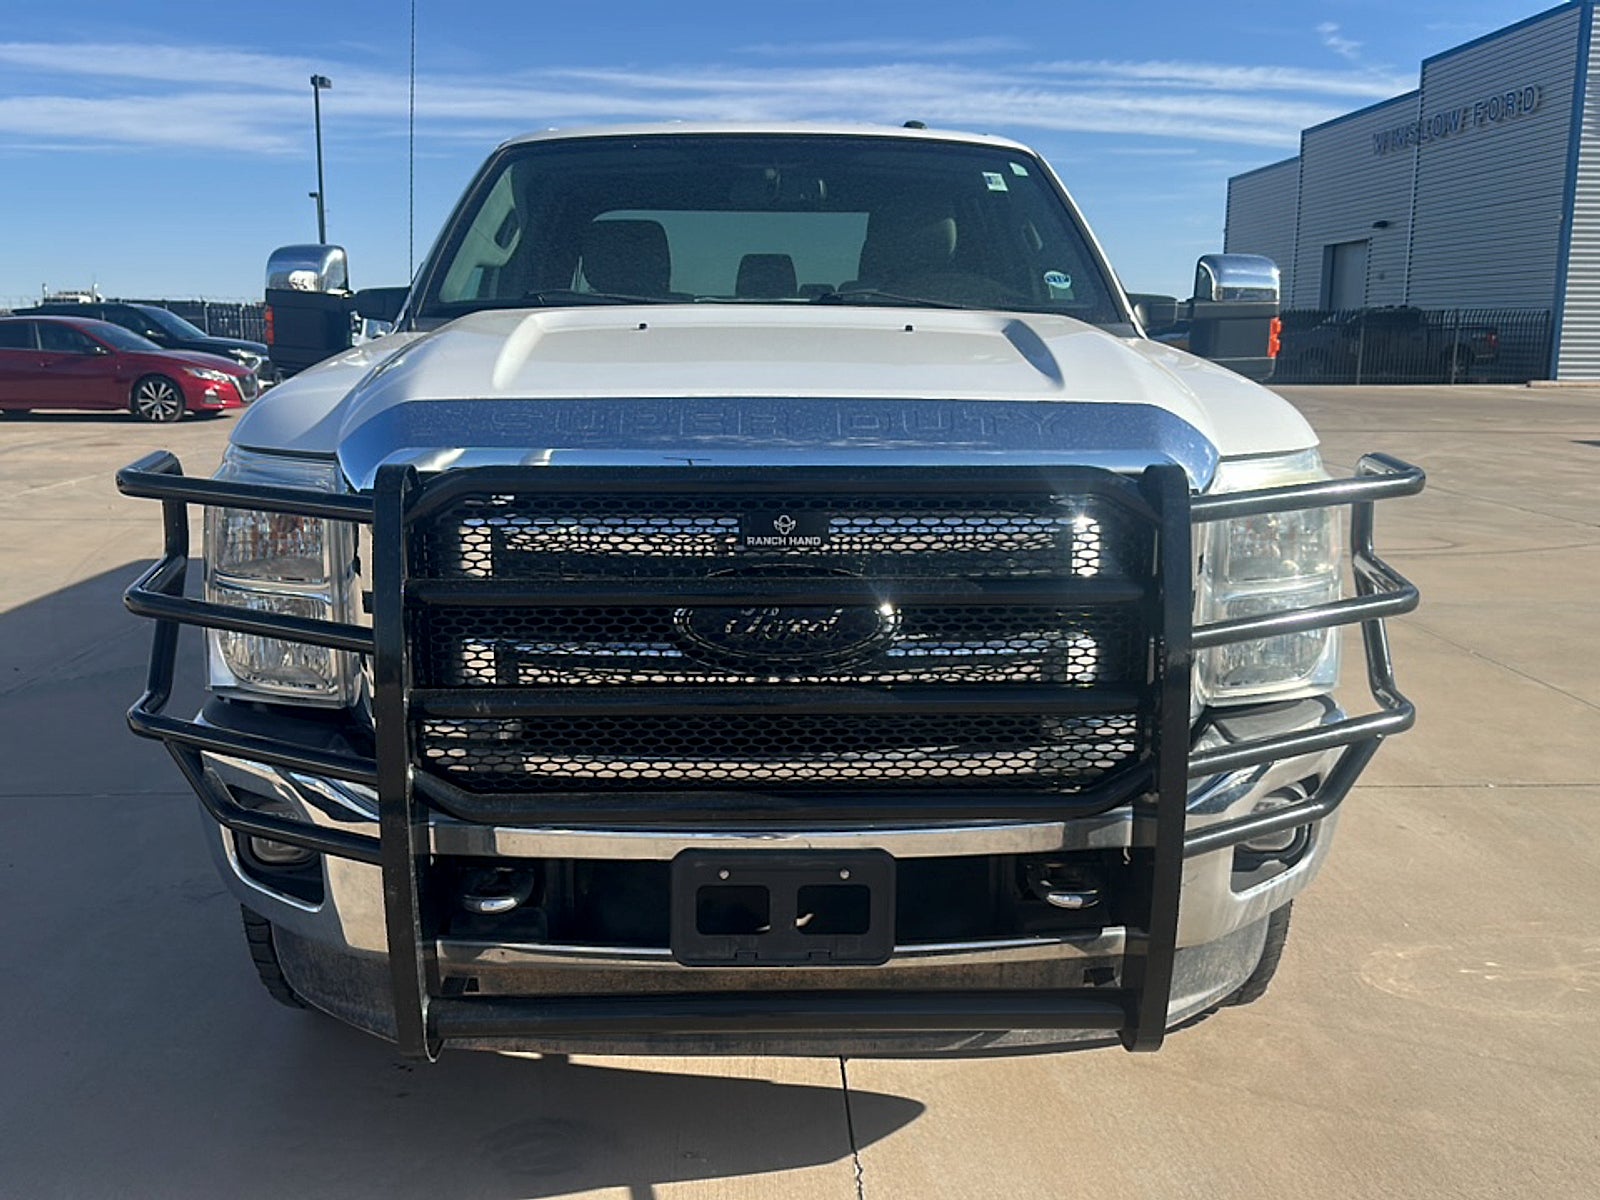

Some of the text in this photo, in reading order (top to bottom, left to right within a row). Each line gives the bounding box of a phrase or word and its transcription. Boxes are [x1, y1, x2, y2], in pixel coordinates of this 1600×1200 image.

[1373, 84, 1541, 154] WINSLOW FORD
[490, 405, 1066, 438] SUPER DUTY
[746, 536, 822, 546] RANCH HAND
[722, 606, 845, 641] Ford
